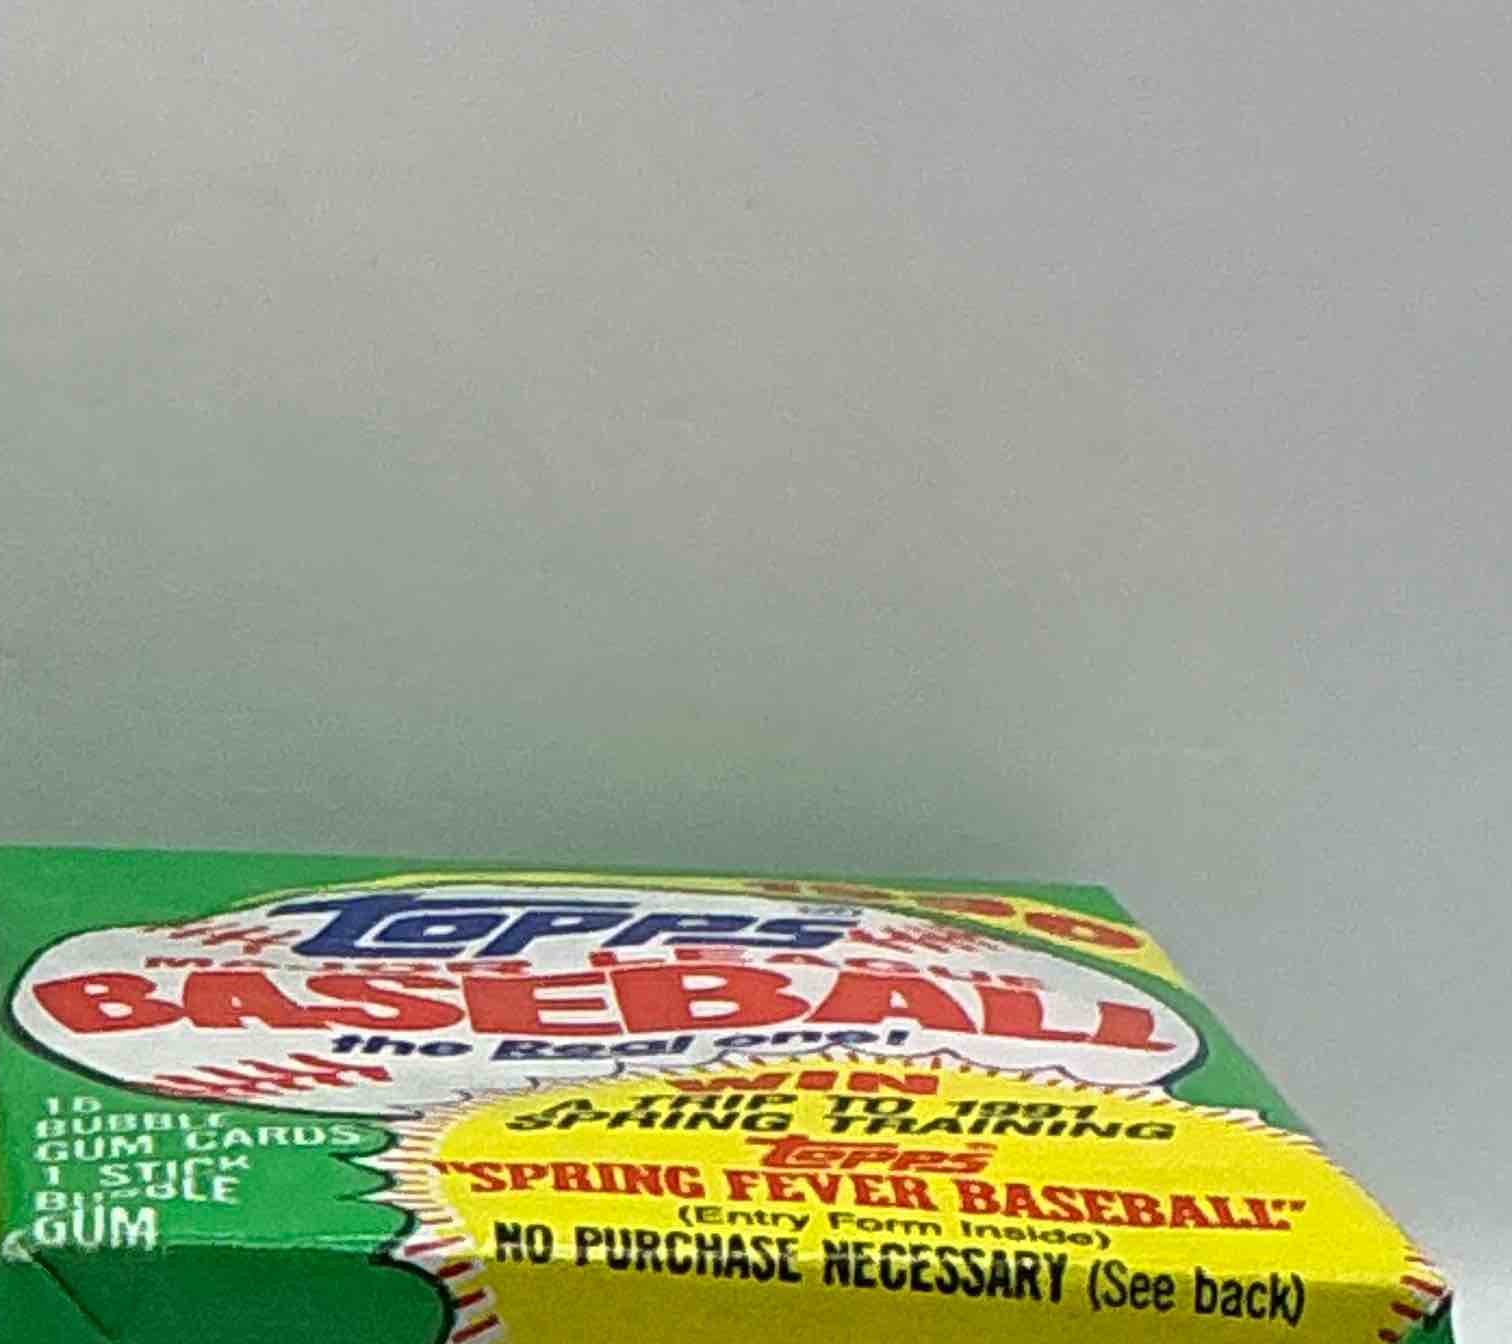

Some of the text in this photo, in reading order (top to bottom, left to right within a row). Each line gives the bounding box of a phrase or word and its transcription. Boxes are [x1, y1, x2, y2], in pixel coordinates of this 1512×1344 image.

[33, 965, 1176, 1052] BASEBALL
[332, 1035, 473, 1056] the
[491, 1035, 694, 1060] Real
[37, 1124, 362, 1162] GUM CARDS
[723, 1168, 939, 1212] FEVER
[34, 1206, 158, 1252] GUM
[679, 1204, 1112, 1250] (Entry Form Inside)
[494, 1220, 1306, 1327] NO PURCHASE NECESSARY (See back)
